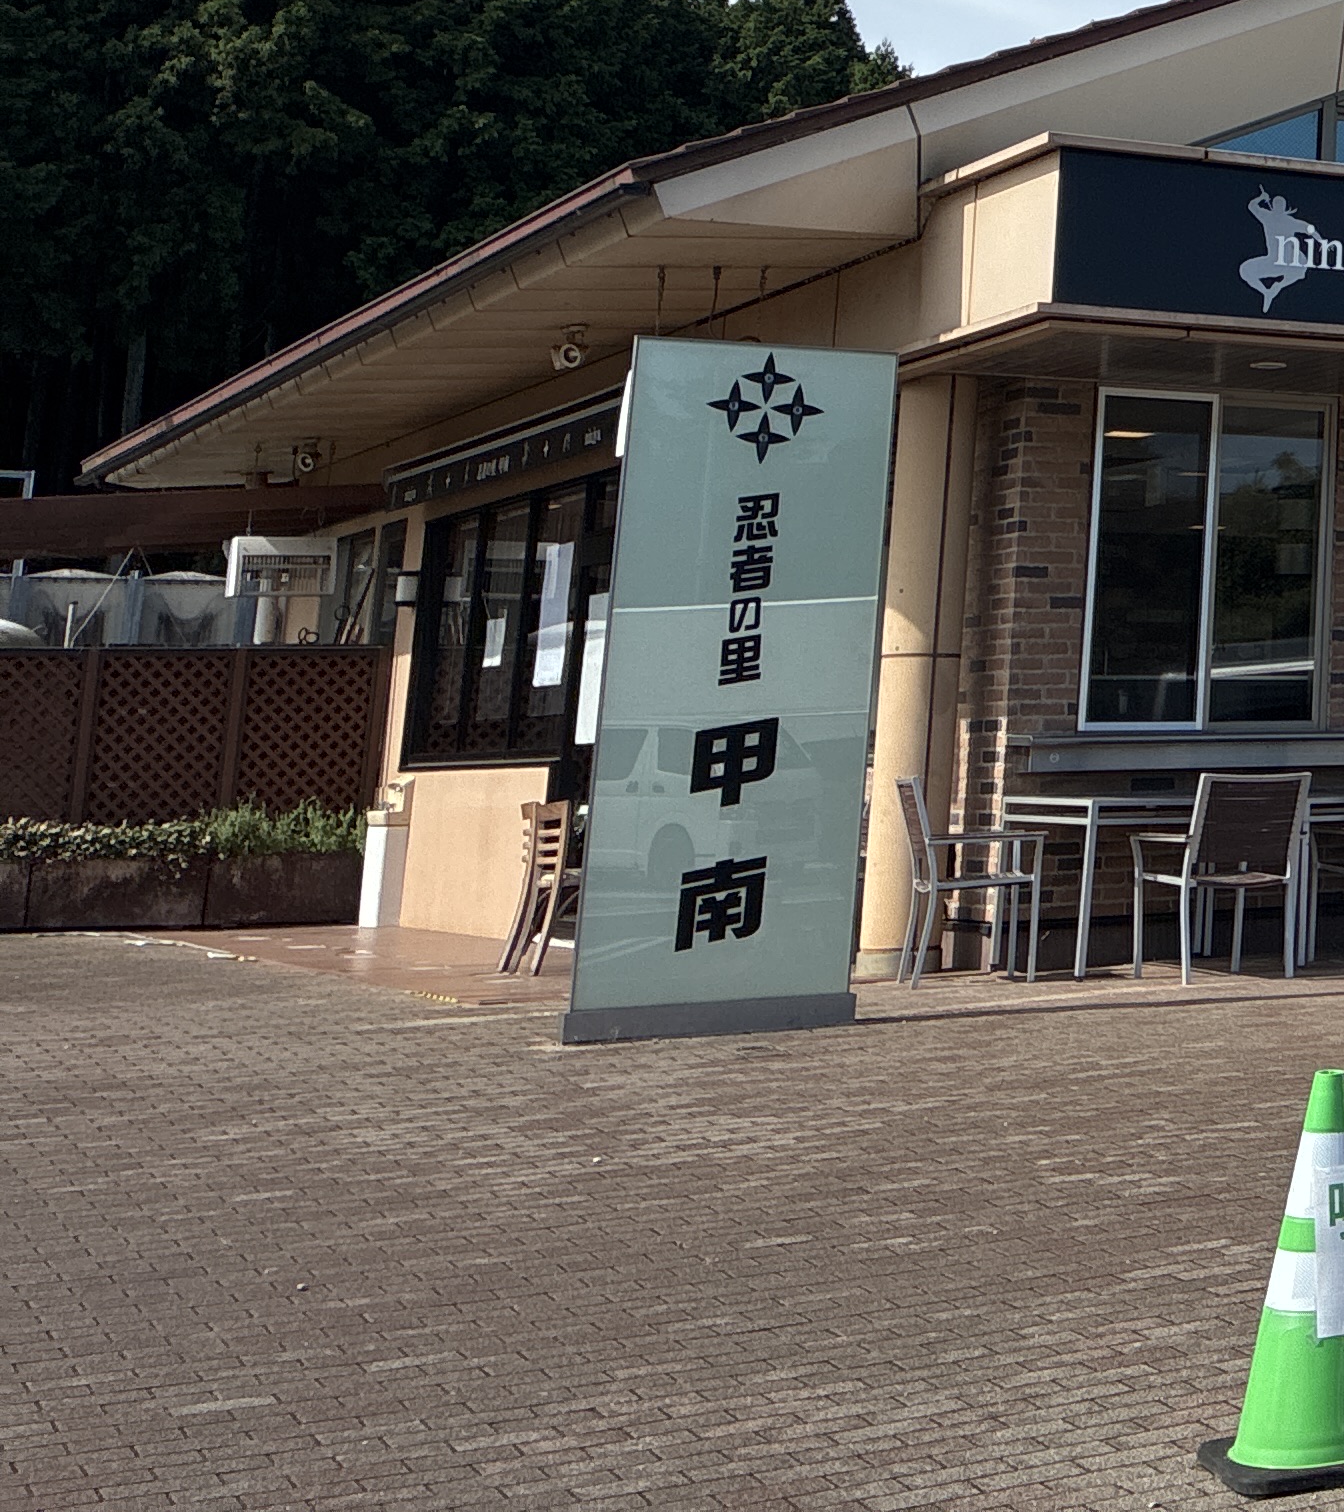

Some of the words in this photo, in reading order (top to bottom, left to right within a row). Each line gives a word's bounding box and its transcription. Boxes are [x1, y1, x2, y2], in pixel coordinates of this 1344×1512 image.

[717, 492, 780, 687] 忍者の里
[674, 716, 780, 953] 甲南
